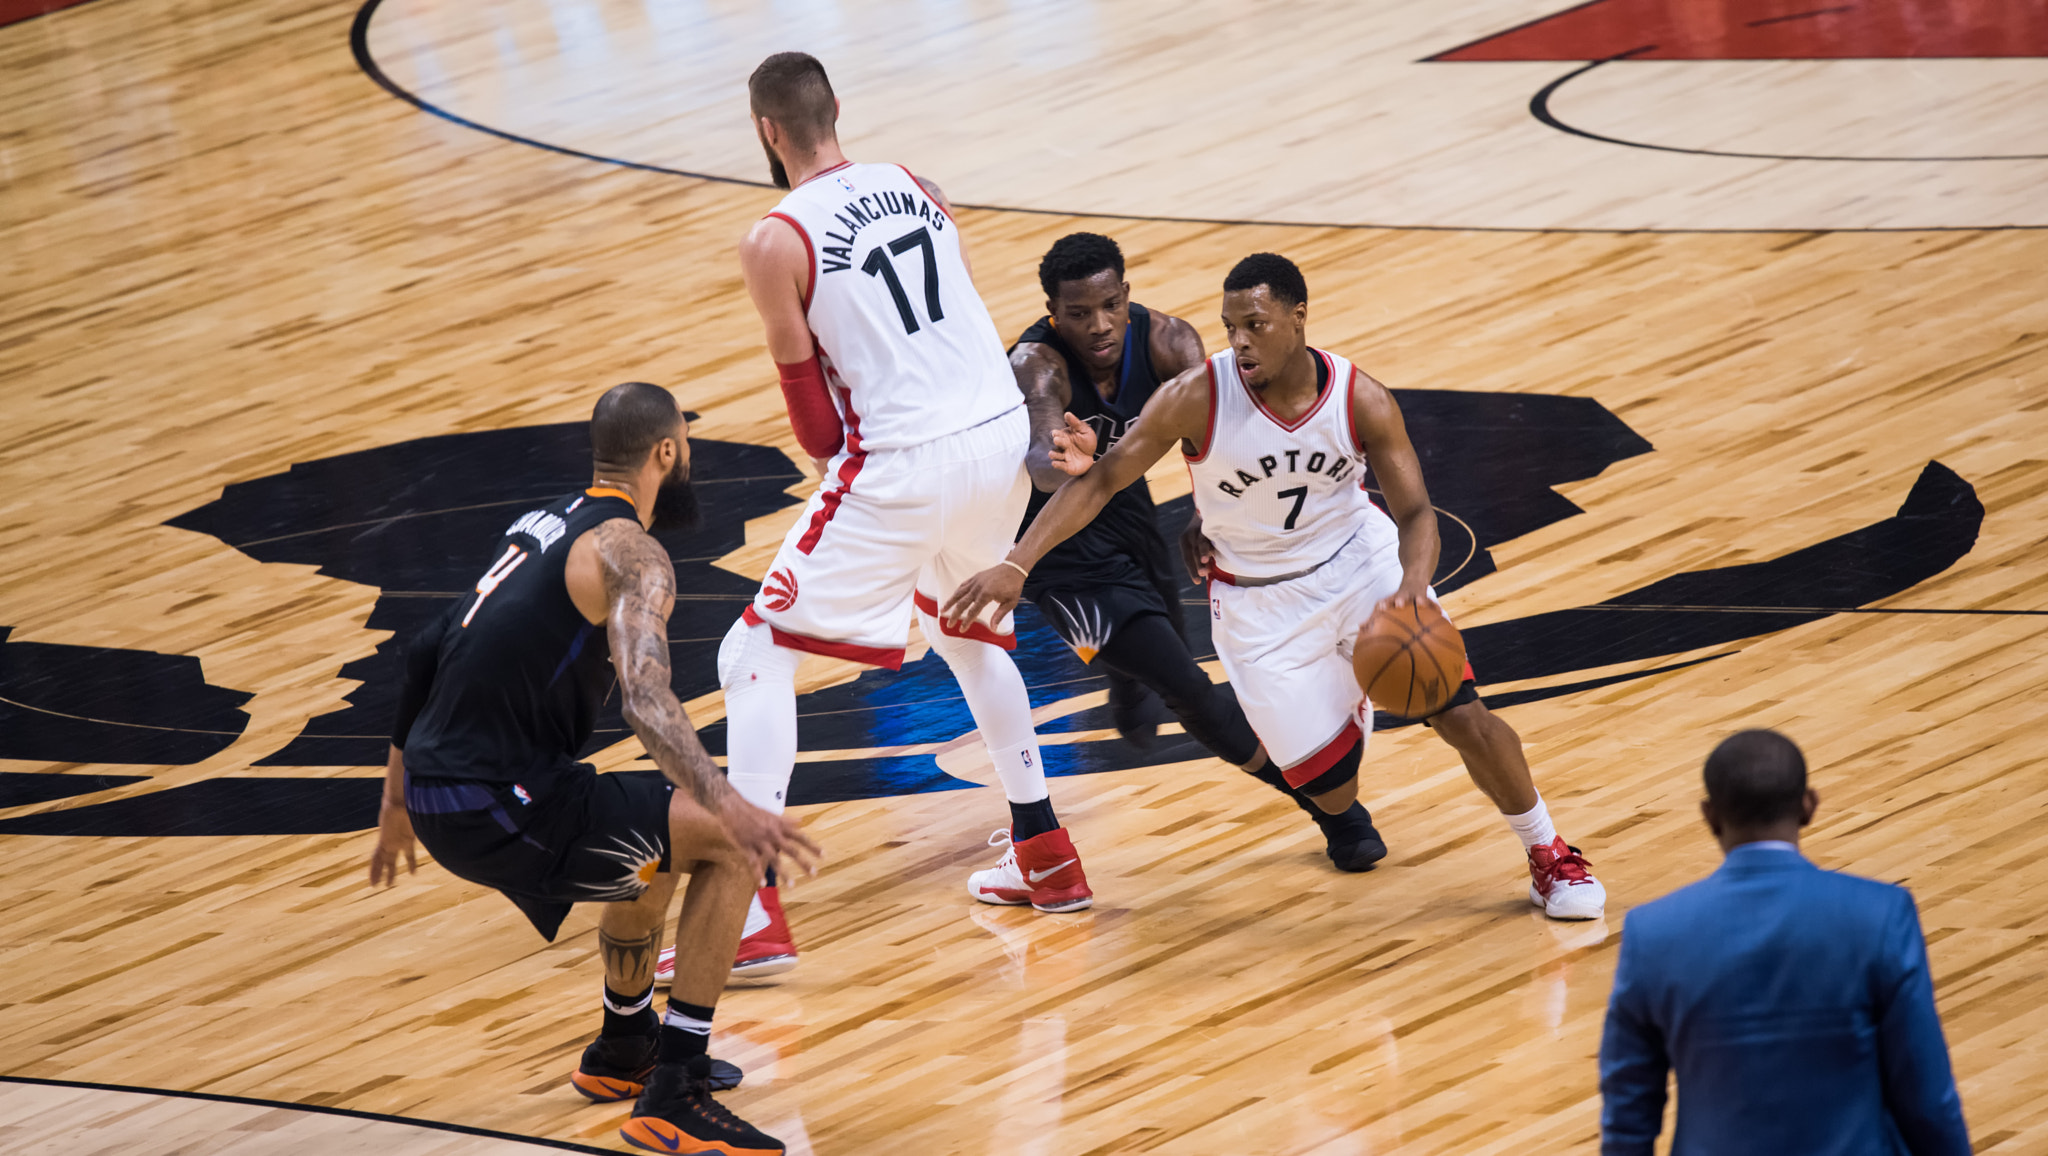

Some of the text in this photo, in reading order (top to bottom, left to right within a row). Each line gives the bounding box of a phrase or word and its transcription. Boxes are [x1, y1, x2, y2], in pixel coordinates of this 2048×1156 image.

[822, 191, 945, 274] VALANCIUNAS
[860, 226, 945, 335] 17
[1277, 485, 1308, 530] 7
[461, 543, 529, 629] 4
